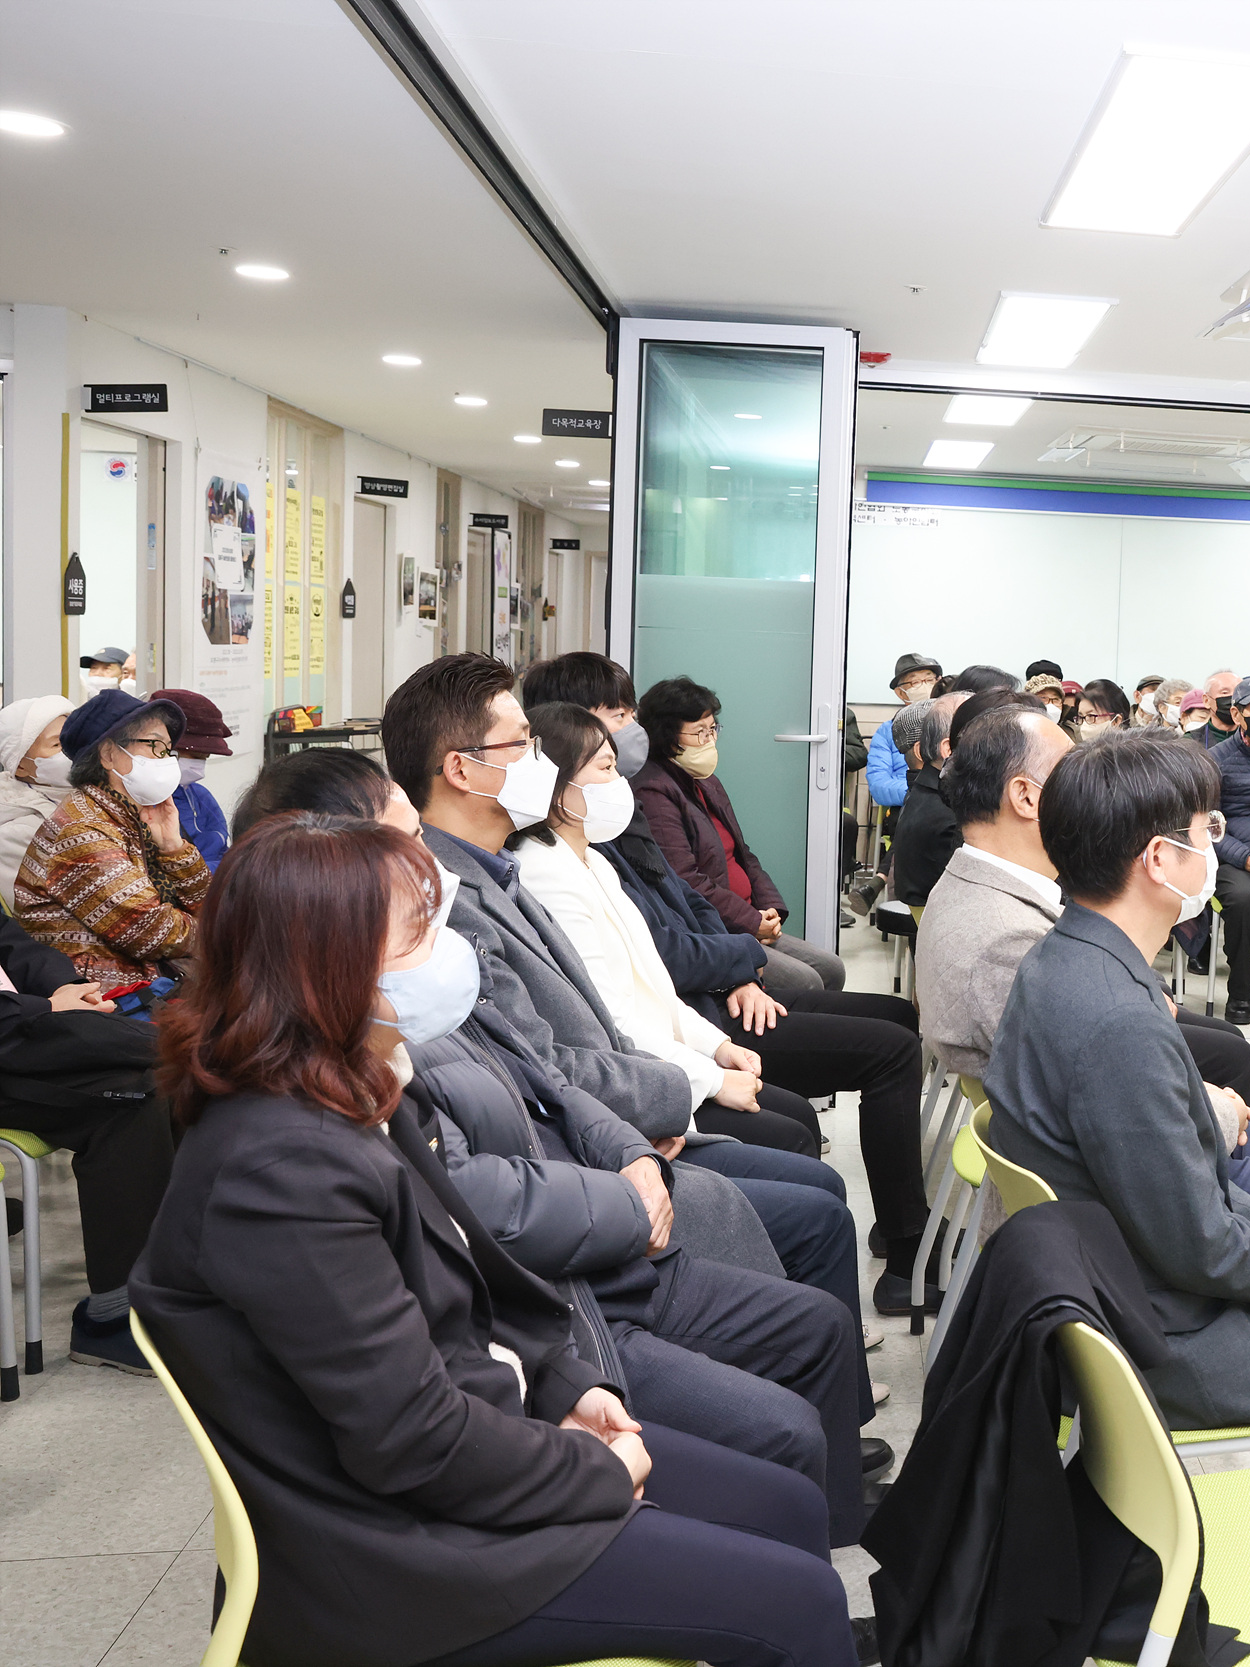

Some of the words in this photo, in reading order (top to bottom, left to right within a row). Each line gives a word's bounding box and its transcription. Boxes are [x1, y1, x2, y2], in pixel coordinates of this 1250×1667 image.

[96, 392, 160, 404] 멀티프로그램실
[552, 418, 602, 430] 다목적교육장
[68, 578, 84, 595] 사용중
